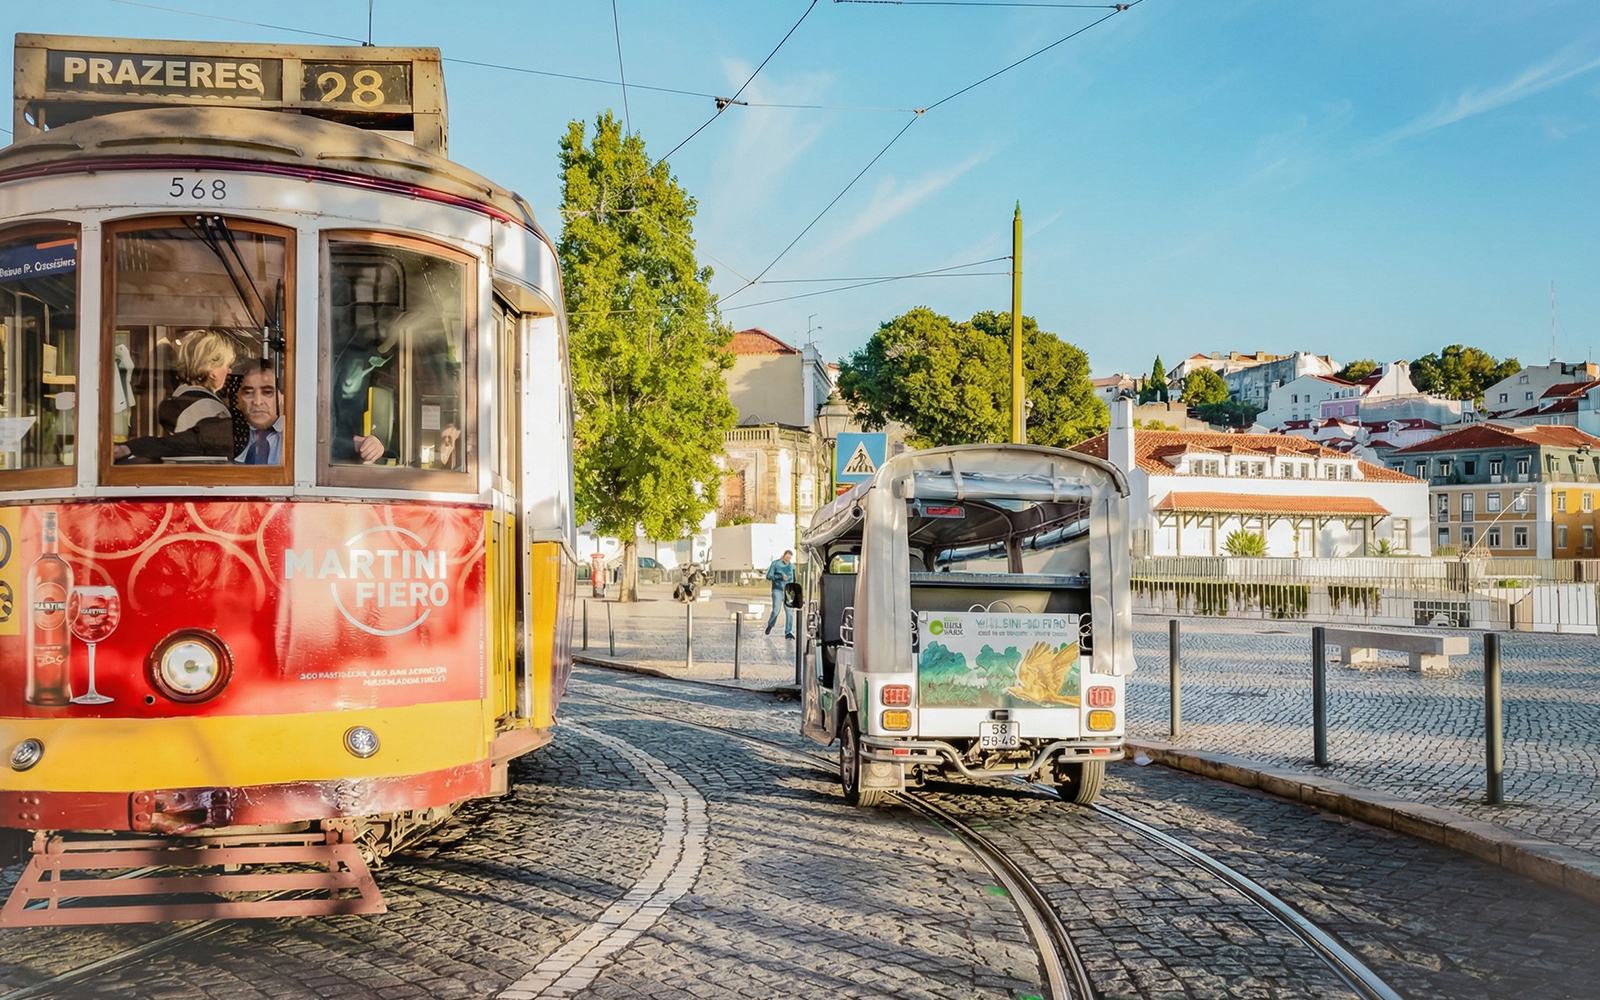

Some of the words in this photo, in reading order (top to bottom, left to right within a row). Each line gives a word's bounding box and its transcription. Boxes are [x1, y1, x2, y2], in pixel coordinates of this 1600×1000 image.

[64, 57, 261, 90] PRAZERES
[317, 70, 385, 108] 28
[169, 177, 227, 200] 568
[284, 549, 447, 579] MARTINI
[356, 582, 449, 607] FIERO
[992, 724, 1007, 735] 58
